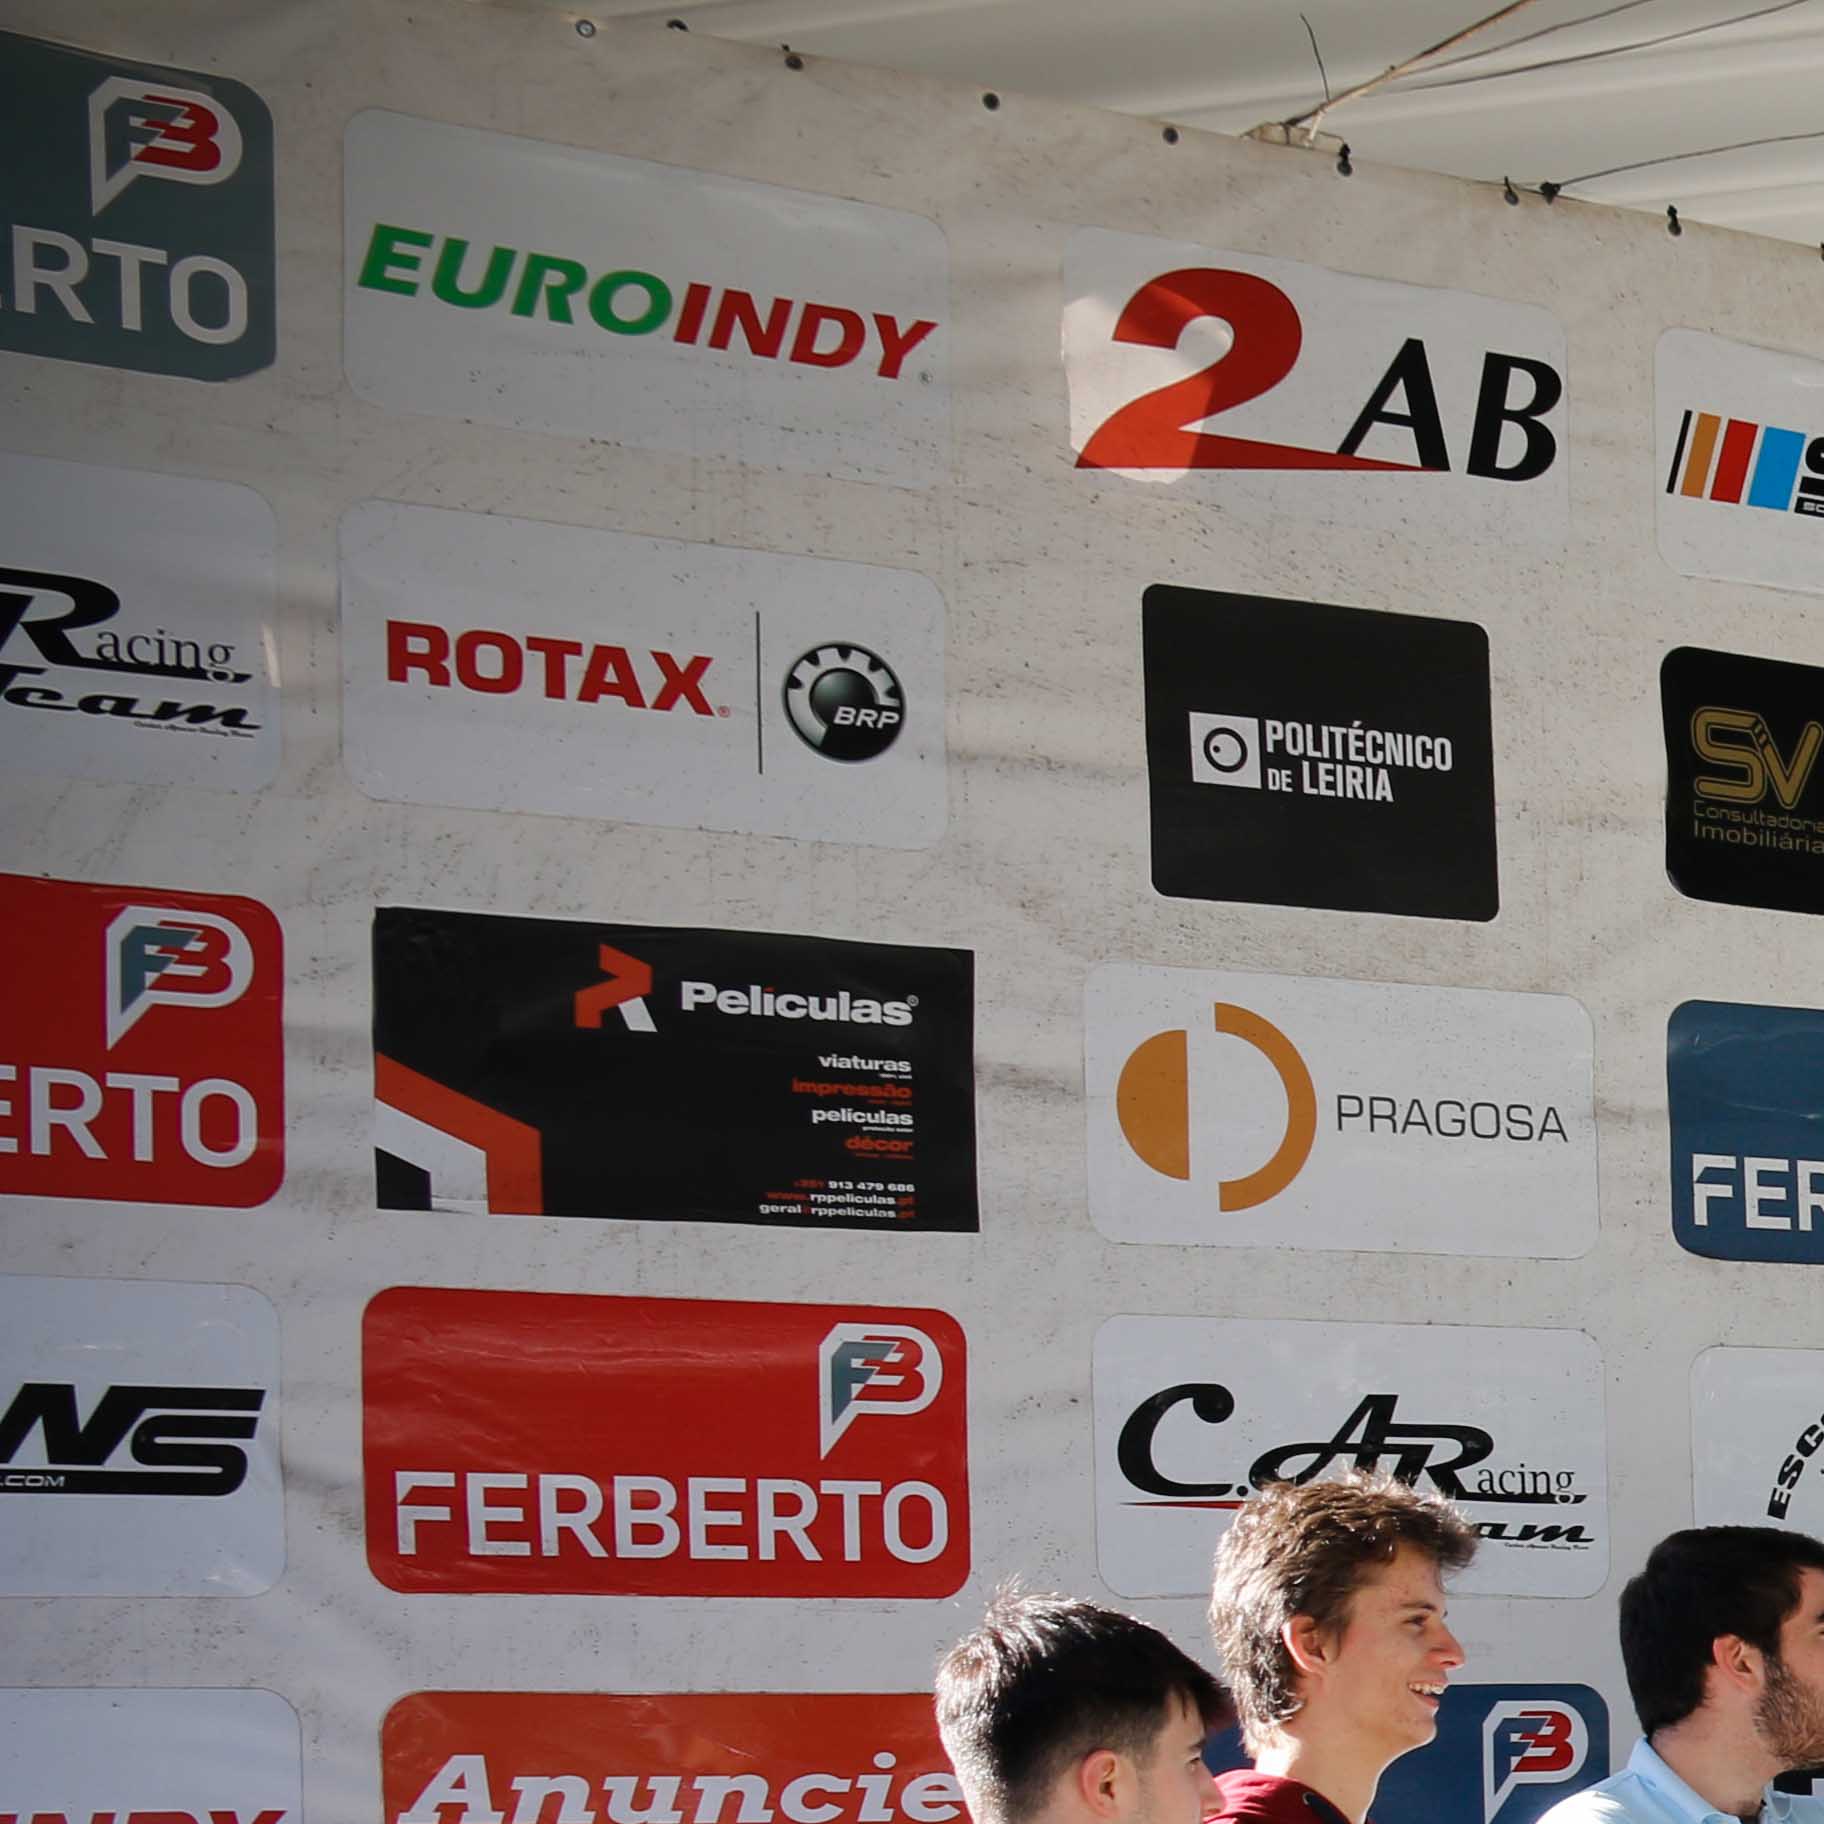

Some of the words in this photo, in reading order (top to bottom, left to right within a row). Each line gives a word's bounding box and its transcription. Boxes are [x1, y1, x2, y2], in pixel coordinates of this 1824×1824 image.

[357, 223, 937, 380] EUROINDY
[386, 619, 714, 717] ROTAX
[834, 704, 900, 732] BRP
[1265, 718, 1453, 772] POLITÉCNICO
[1267, 768, 1293, 792] DE
[1302, 761, 1394, 803] LEIRIA
[1690, 705, 1824, 809] SV
[818, 1053, 912, 1072] viaturas
[1336, 1094, 1568, 1143] PRAGOSA
[396, 1470, 948, 1563] FERBERTO
